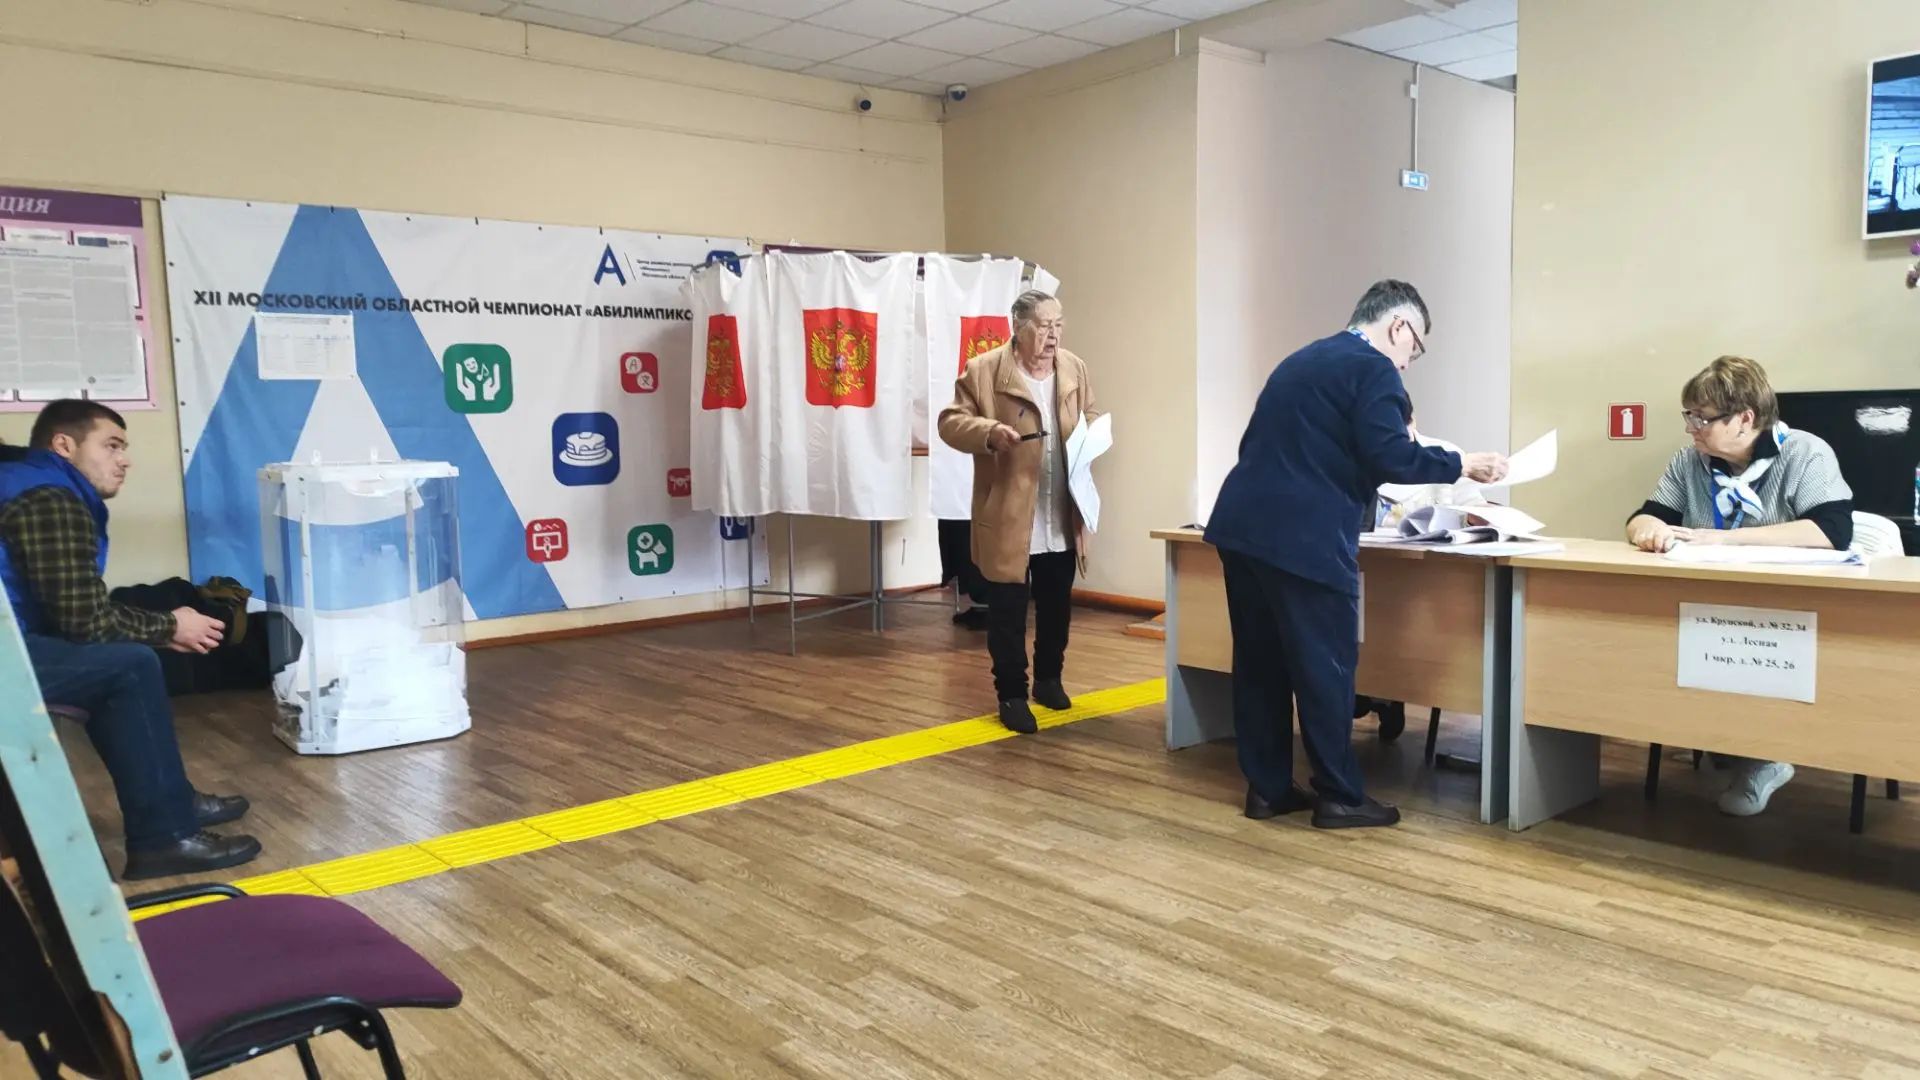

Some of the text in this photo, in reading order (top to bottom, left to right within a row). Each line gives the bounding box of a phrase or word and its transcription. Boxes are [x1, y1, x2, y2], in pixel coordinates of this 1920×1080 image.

[193, 290, 222, 306] XII
[227, 291, 367, 312] МОСКОВСКИЙ
[373, 297, 480, 314] ОБЛАСТНОЙ
[484, 301, 583, 318] ЧЕМПИОНАТ
[1740, 636, 1778, 648] Лесная
